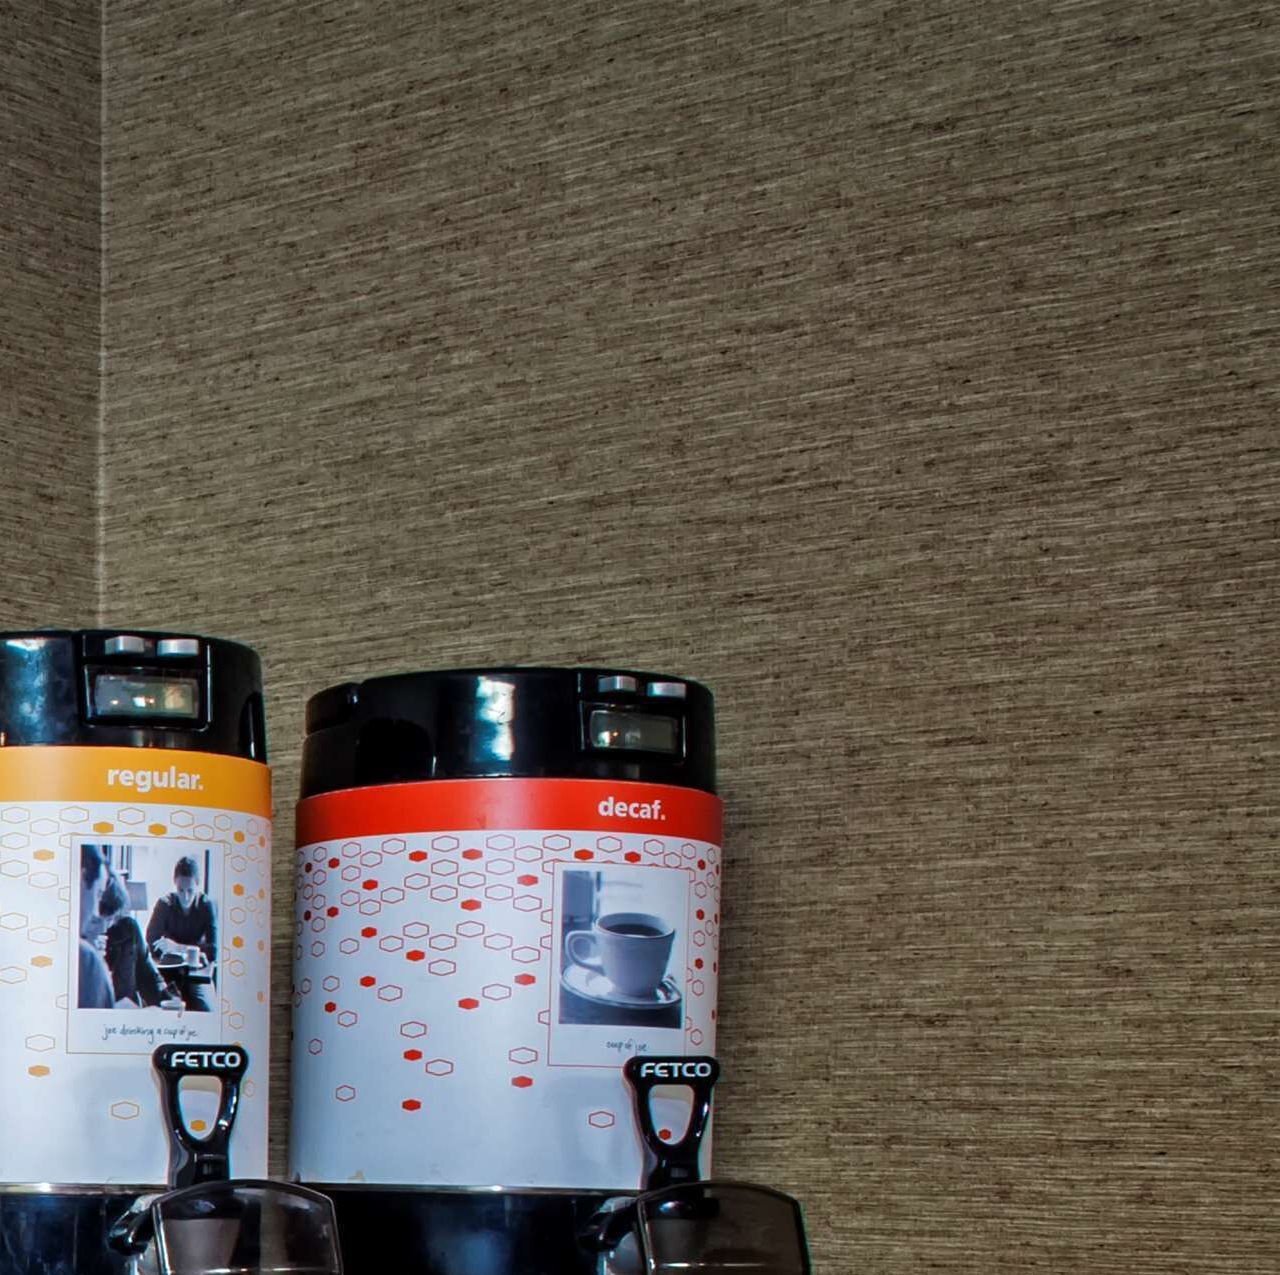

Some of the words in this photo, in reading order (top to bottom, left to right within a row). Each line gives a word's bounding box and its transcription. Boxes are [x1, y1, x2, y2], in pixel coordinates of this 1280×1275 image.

[106, 765, 204, 793] regular.
[598, 796, 666, 821] decaf.
[171, 1051, 241, 1068] FETCO
[641, 1062, 712, 1078] FETCO
